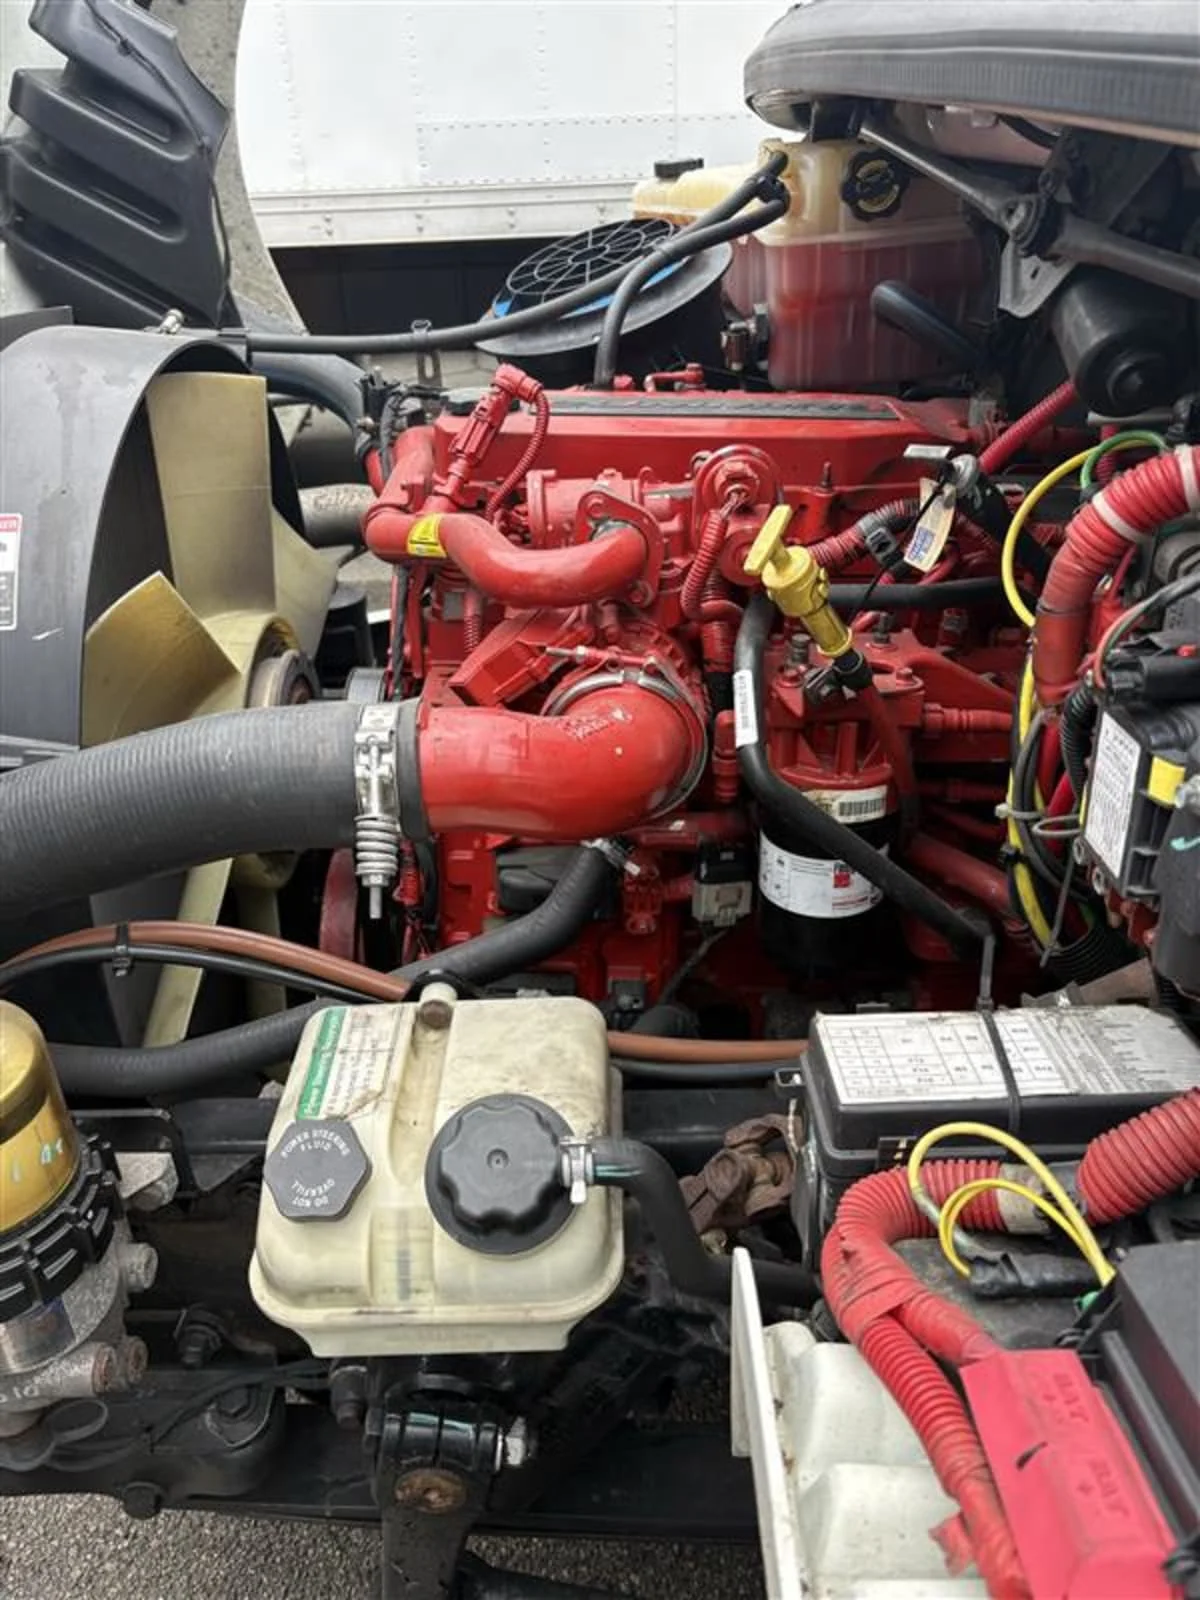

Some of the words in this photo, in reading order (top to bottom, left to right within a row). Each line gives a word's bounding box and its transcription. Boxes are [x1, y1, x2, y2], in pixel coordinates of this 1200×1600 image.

[280, 1131, 310, 1158] POWER
[311, 1128, 351, 1156] STEERING
[299, 1139, 332, 1152] FLUID
[290, 1177, 336, 1197] OVERFILL
[291, 1196, 311, 1208] NOT
[313, 1195, 329, 1207] DO
